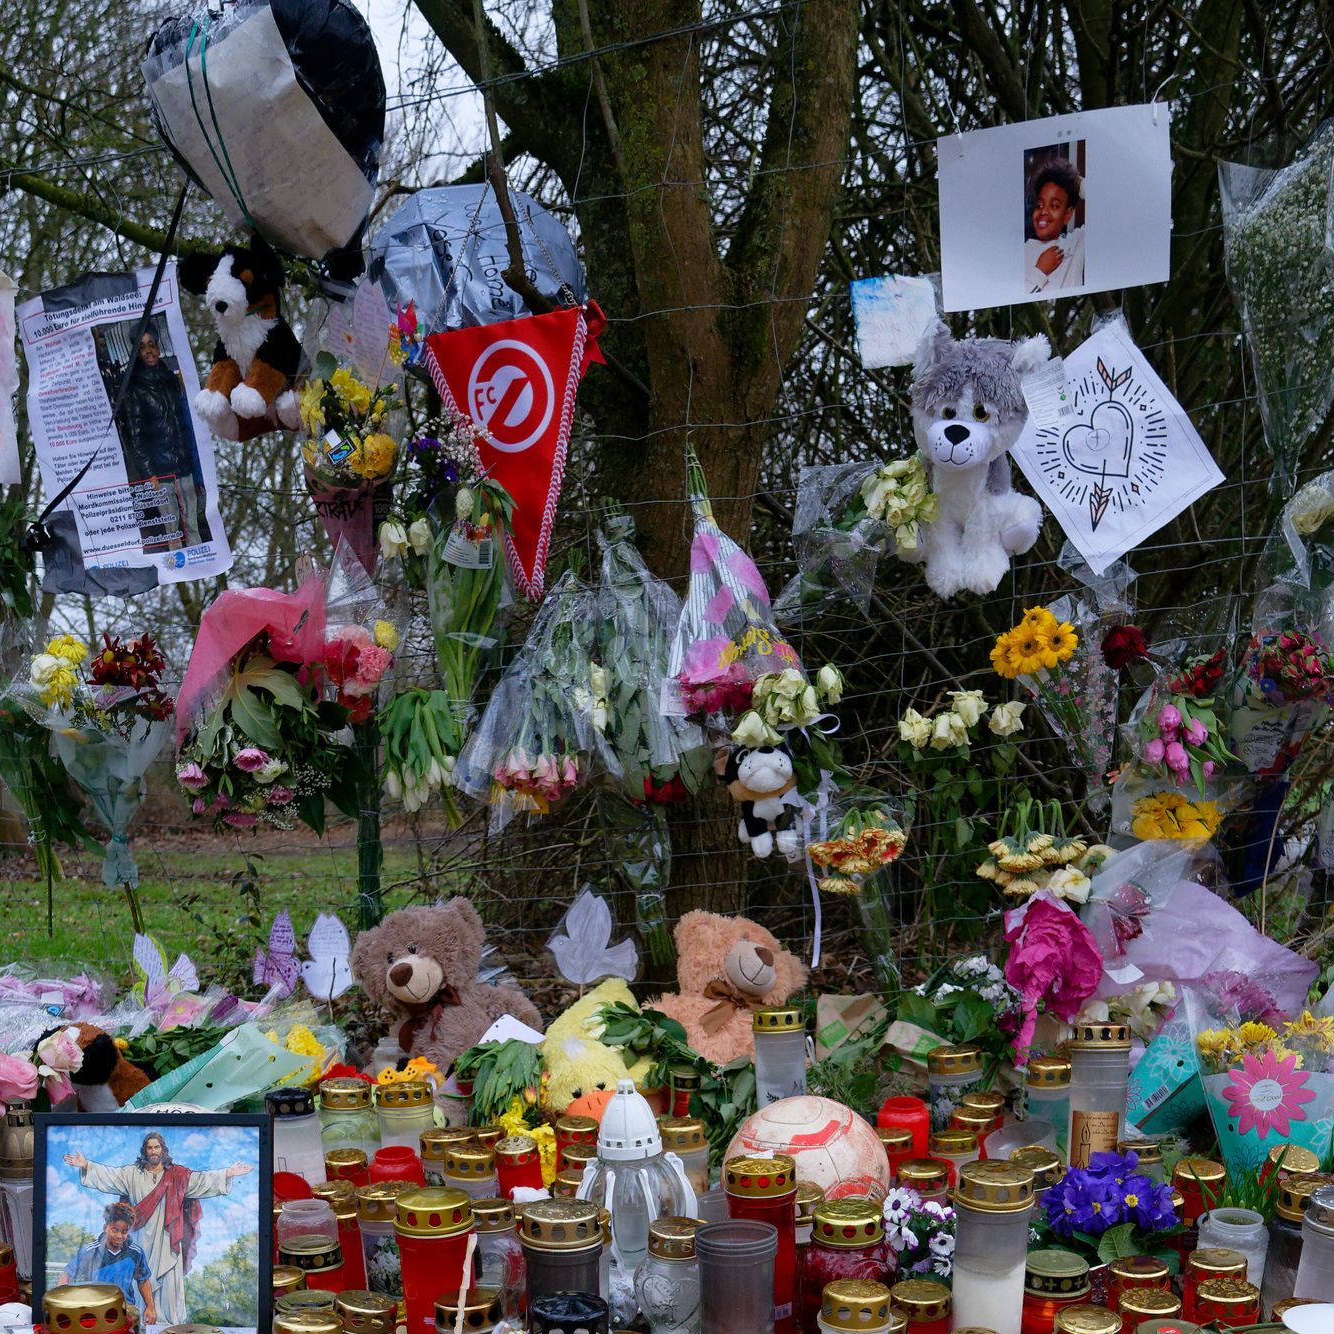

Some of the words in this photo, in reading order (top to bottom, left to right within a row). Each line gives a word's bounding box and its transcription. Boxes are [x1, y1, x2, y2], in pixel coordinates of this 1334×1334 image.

[107, 292, 142, 303] Waldsee:
[34, 324, 53, 338] 10.000
[54, 320, 69, 331] Euro
[70, 317, 79, 327] für
[81, 306, 127, 321] zielführende
[129, 297, 163, 310] Hinwse
[87, 490, 117, 500] Hinweise
[118, 486, 134, 495] bitte
[135, 484, 143, 492] an
[144, 481, 155, 490] die
[78, 496, 134, 510] Mordkommission
[81, 505, 134, 518] Polizeipräsidium
[110, 515, 126, 523] 0211
[128, 511, 145, 520] 8700
[85, 528, 99, 536] oder
[100, 526, 115, 535] jede
[116, 515, 176, 531] Polizeidienststelle
[187, 545, 211, 557] POLIZEI
